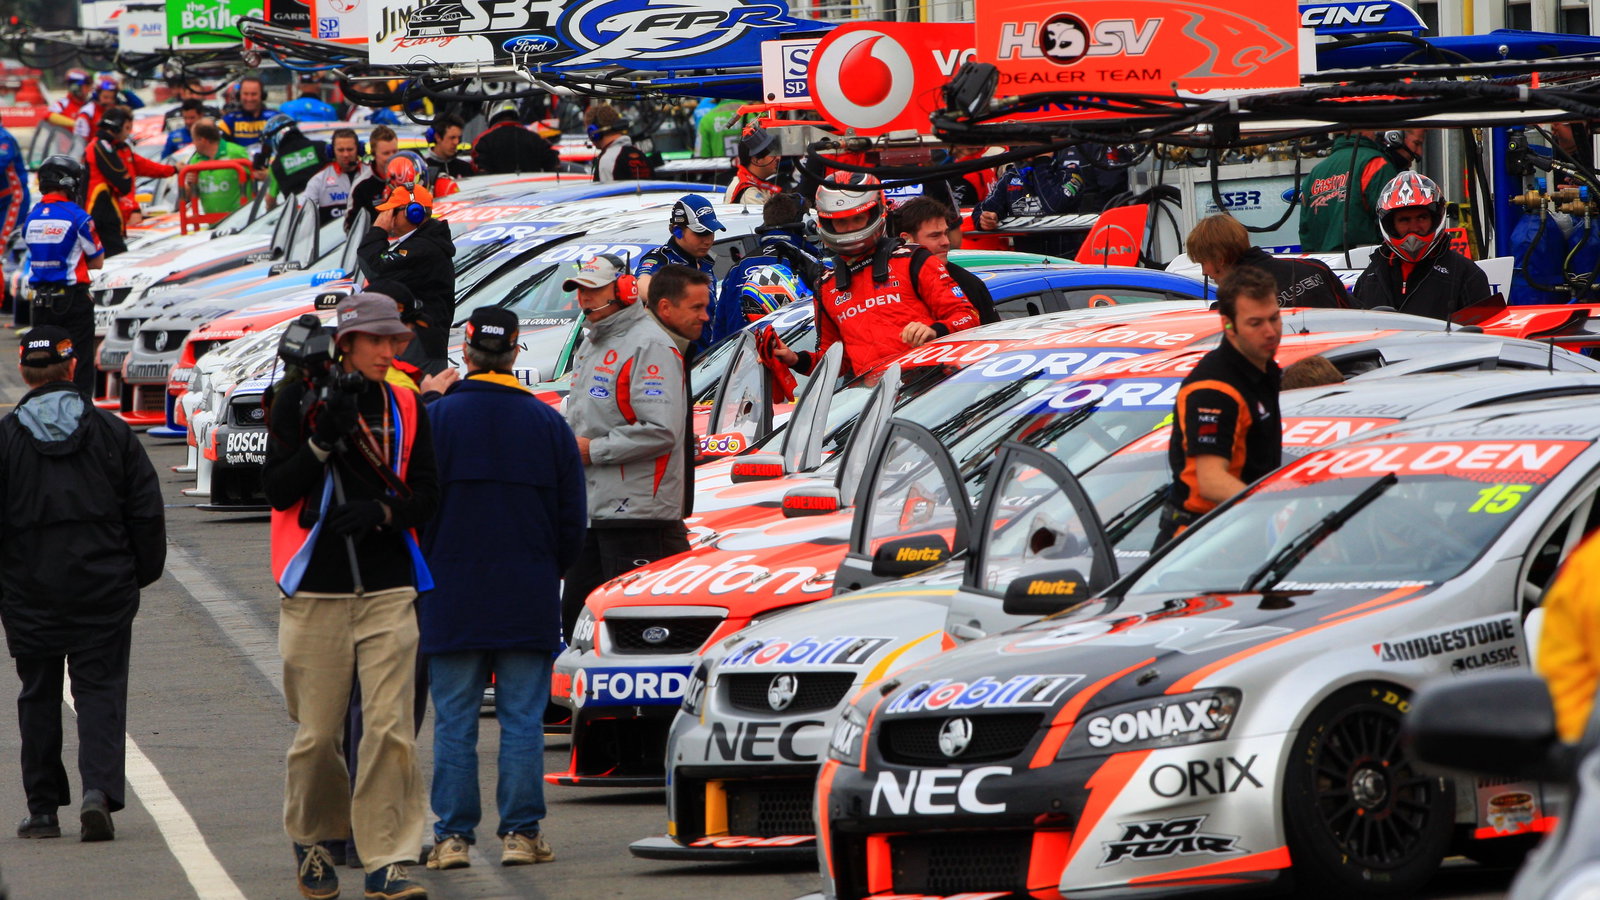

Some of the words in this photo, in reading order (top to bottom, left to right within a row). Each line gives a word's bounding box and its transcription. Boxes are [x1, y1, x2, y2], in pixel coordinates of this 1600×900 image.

[1300, 4, 1391, 26] CING
[319, 19, 339, 33] SP
[512, 38, 548, 53] Ford
[1000, 71, 1086, 86] DEALER
[1100, 69, 1161, 83] TEAM
[1094, 246, 1133, 256] MAN
[850, 258, 873, 272] HOLDEN
[836, 293, 902, 324] HOLDEN
[481, 325, 505, 336] 2008
[28, 339, 50, 349] 2008
[592, 388, 608, 396] Ford
[1198, 415, 1219, 424] NEC
[226, 432, 269, 452] BOSCH
[700, 436, 739, 452] dodo
[225, 452, 245, 464] Spark
[1283, 443, 1564, 479] HOLDEN
[1467, 484, 1532, 514] 15
[896, 547, 942, 562] Hertz
[1027, 580, 1077, 595] Hertz
[1382, 618, 1515, 662] BRIDGESTONE
[722, 637, 849, 666] Mobil
[1466, 646, 1518, 670] CLASSIC
[592, 672, 688, 700] FORD
[886, 675, 1027, 714] Mobil
[1087, 699, 1218, 748] SONAX
[704, 720, 825, 762] NEC
[1150, 753, 1264, 798] ORIX
[868, 766, 1013, 816] NEC
[1122, 818, 1202, 840] NO
